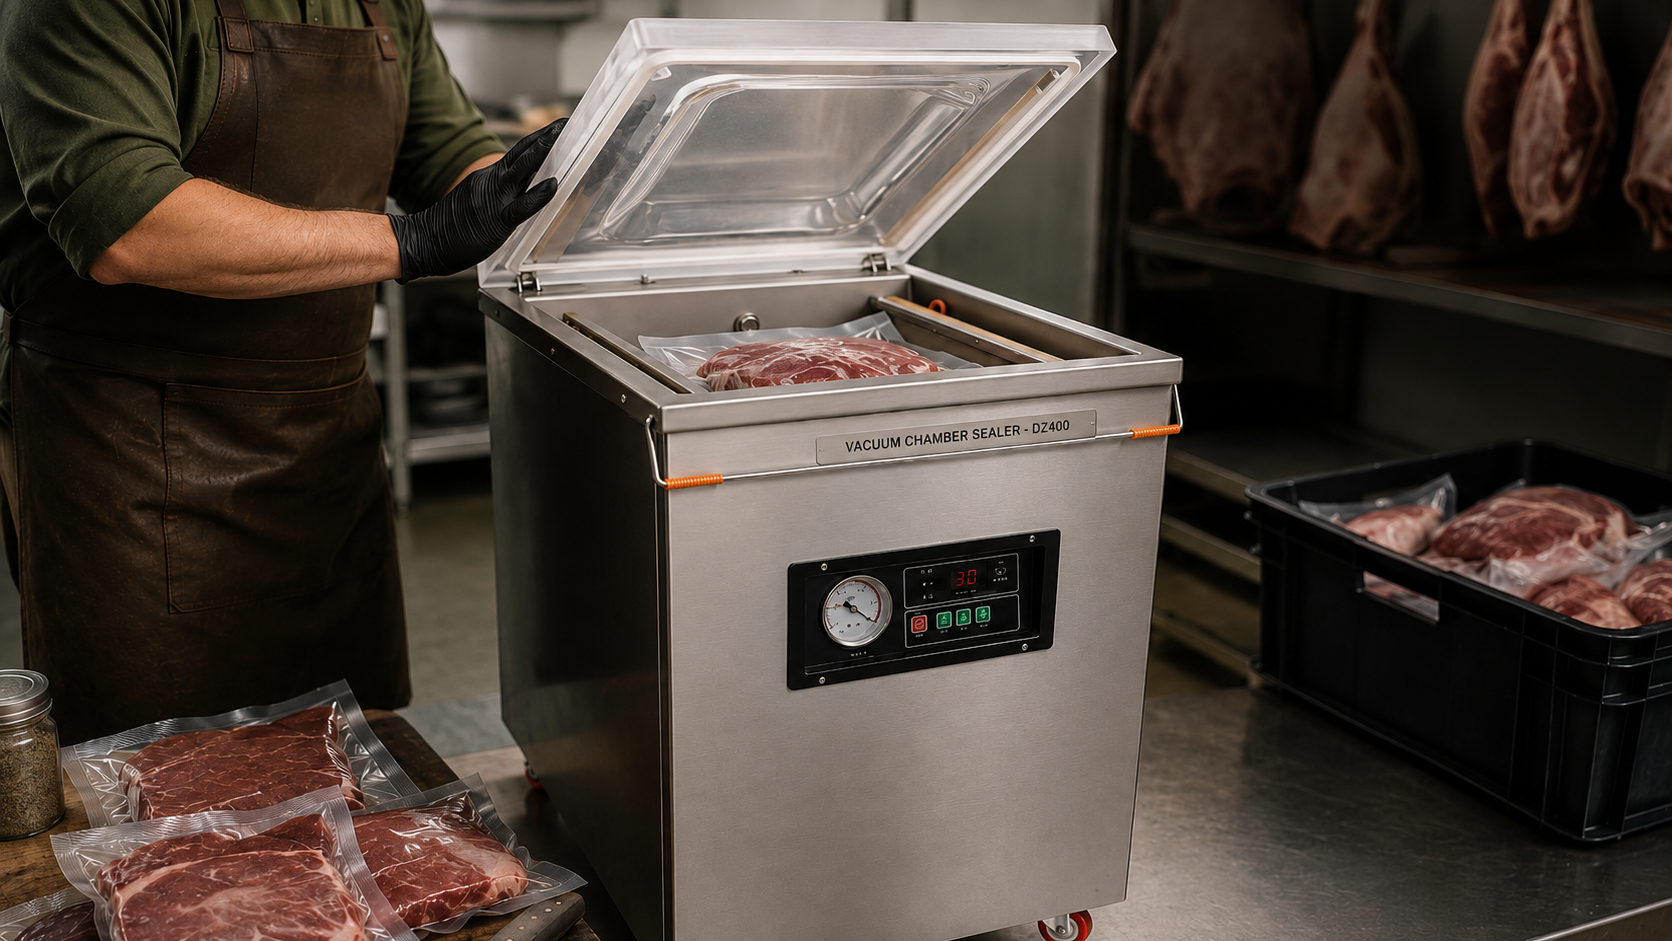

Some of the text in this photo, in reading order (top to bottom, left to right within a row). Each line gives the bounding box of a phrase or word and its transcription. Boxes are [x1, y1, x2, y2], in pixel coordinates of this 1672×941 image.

[845, 436, 901, 453] VACUUM
[904, 429, 968, 447] CHAMBER
[972, 424, 1021, 440] SEALER
[1032, 420, 1070, 434] DZ400
[956, 569, 977, 587] 30
